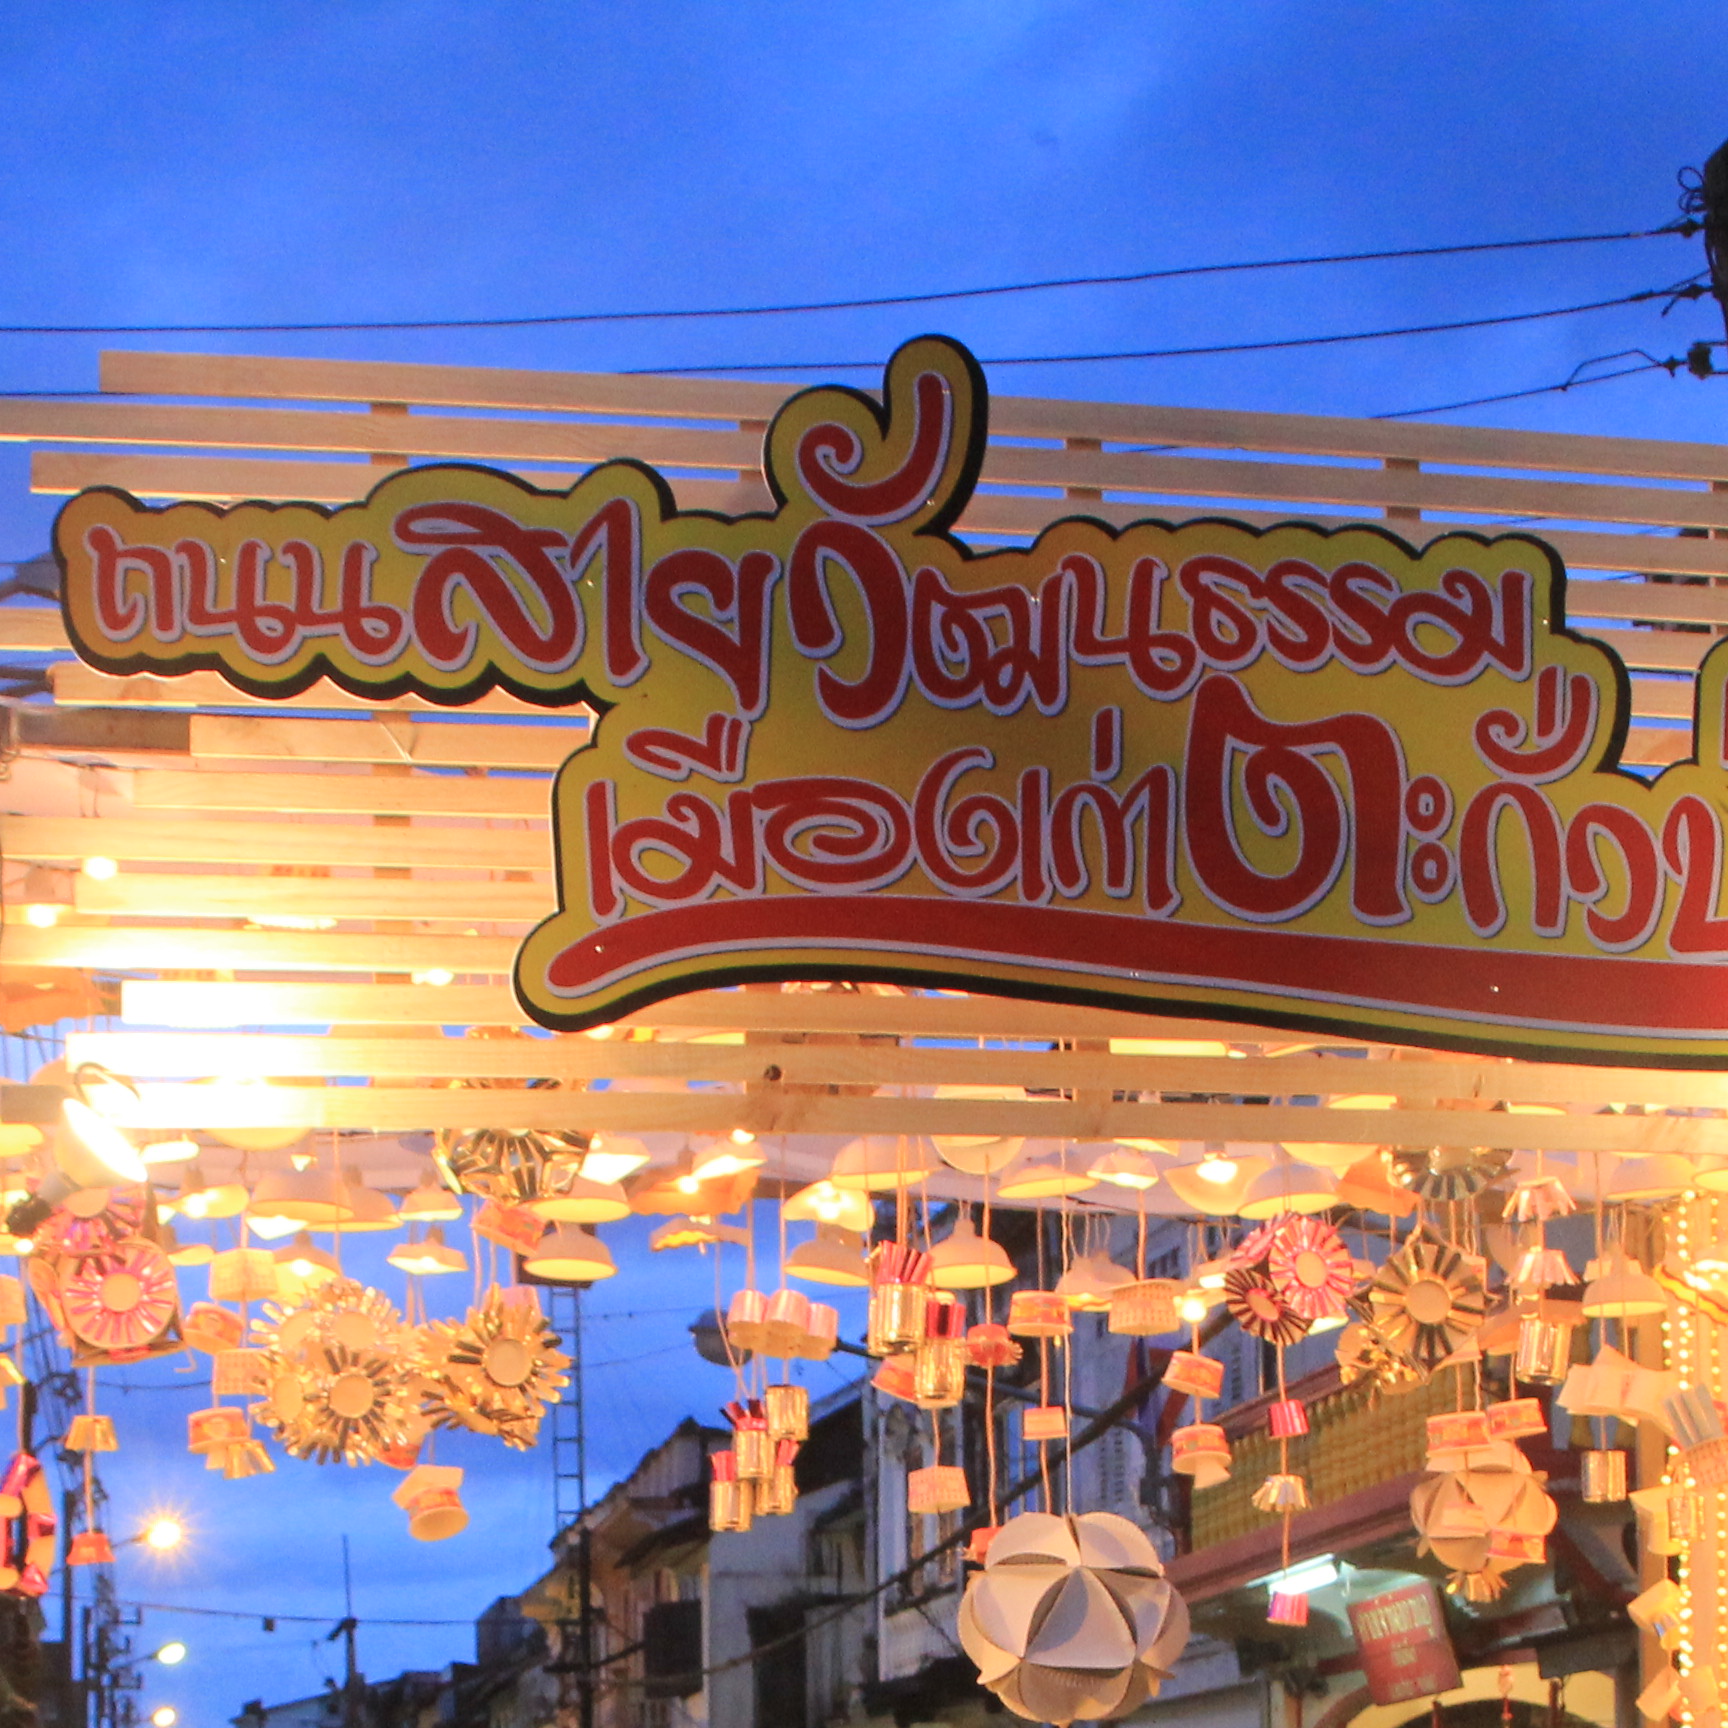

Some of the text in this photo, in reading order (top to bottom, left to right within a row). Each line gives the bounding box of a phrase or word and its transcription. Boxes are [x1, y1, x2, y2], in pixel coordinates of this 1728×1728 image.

[88, 370, 1534, 728] ถนนสายวัฒนธรรม
